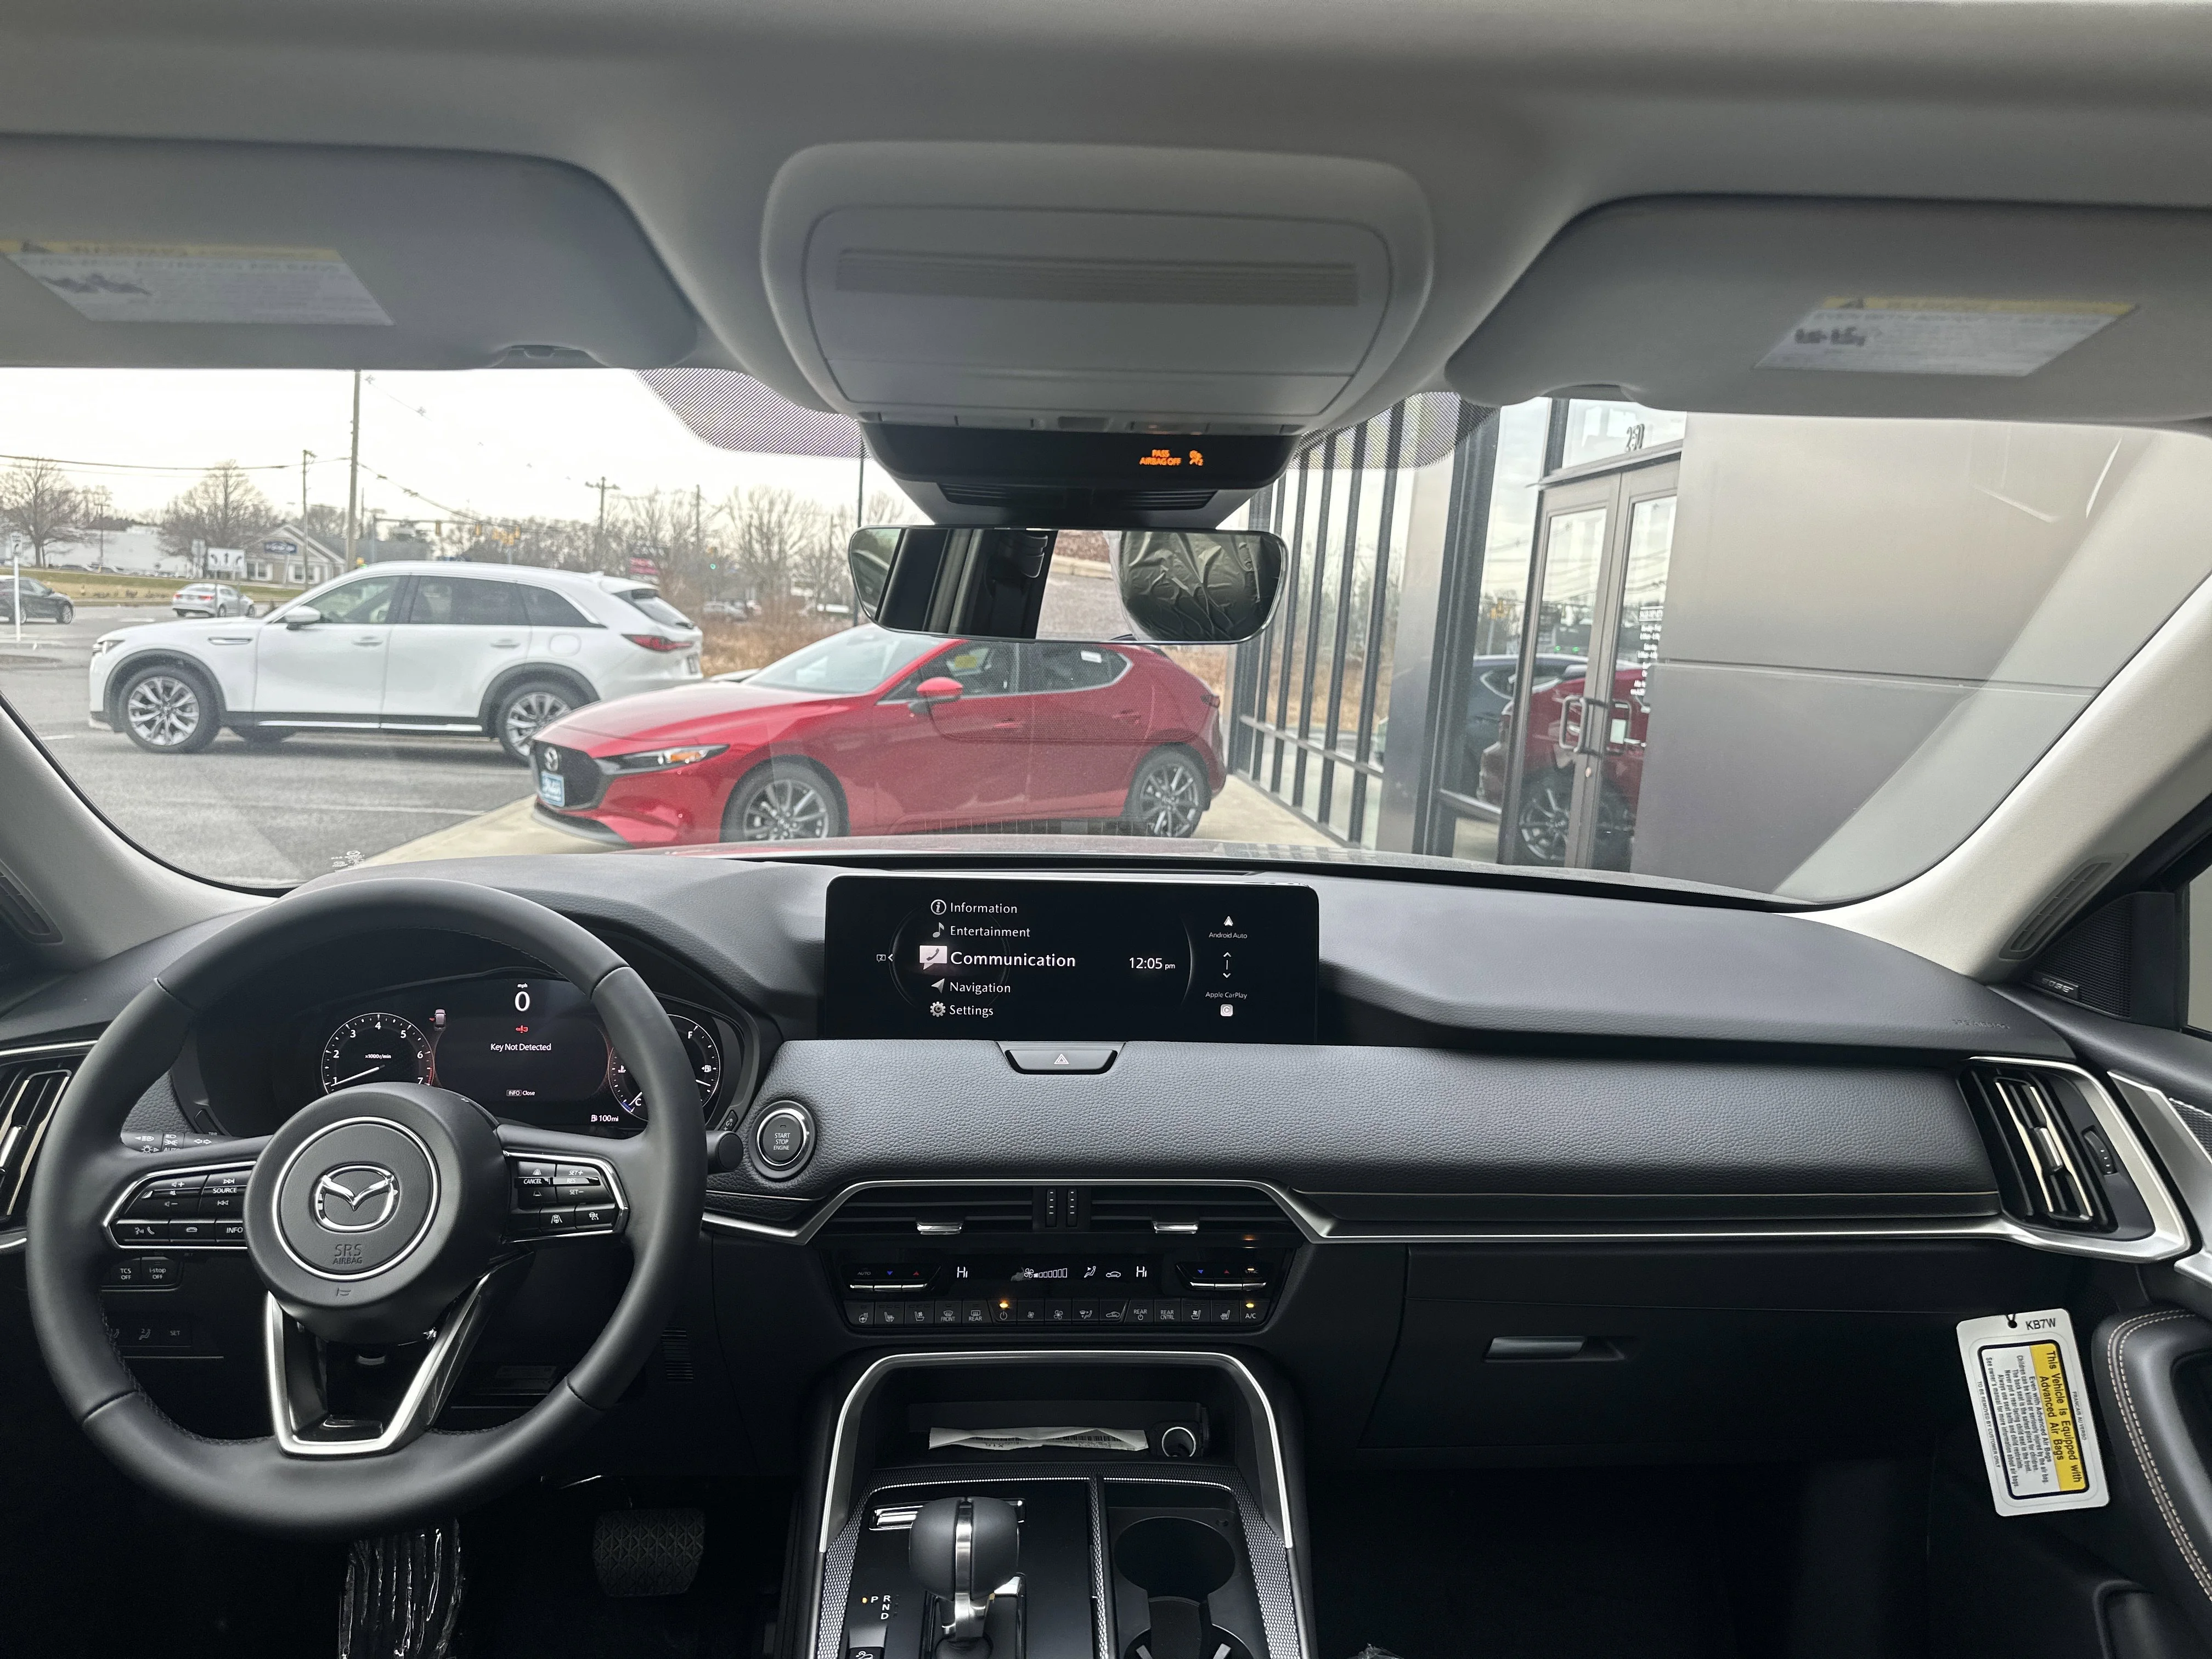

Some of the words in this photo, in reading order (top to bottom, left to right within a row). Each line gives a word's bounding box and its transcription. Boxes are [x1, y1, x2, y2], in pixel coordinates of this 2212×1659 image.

[1139, 457, 1167, 465] AIRBAG
[950, 902, 1018, 914] Information
[950, 926, 1031, 937] Entertainment
[950, 952, 1076, 967] Communication
[1129, 957, 1163, 969] 12:05
[950, 982, 1011, 995] Navigation
[2041, 978, 2074, 993] BOSE
[514, 991, 531, 1012] 0
[950, 1005, 994, 1019] Settings
[375, 1022, 381, 1030] 4
[350, 1030, 356, 1038] 3
[400, 1030, 407, 1039] 5
[688, 1031, 693, 1039] F
[333, 1050, 340, 1058] 2
[490, 1043, 504, 1052] Key
[505, 1043, 518, 1051] Not
[519, 1043, 551, 1051] Detected
[417, 1050, 424, 1059] 6
[635, 1098, 642, 1106] C
[334, 1244, 363, 1257] SRS
[2025, 1318, 2057, 1330] KB7W
[2046, 1350, 2057, 1369] This
[2016, 1355, 2025, 1375] Children
[2025, 1392, 2033, 1405] killed
[2051, 1373, 2064, 1403] Vehicle
[2016, 1391, 2024, 1401] seat
[2039, 1376, 2057, 1417] Advanced
[1988, 1368, 1997, 1386] owner's
[1993, 1387, 2002, 1404] manual
[2001, 1426, 2011, 1453] information
[2007, 1454, 2016, 1466] about
[2022, 1415, 2030, 1430] safest
[2036, 1407, 2047, 1435] Advanced
[1980, 1396, 1989, 1419] REMOVED
[1988, 1428, 1997, 1454] CUSTOMER
[2016, 1423, 2024, 1435] child
[2049, 1422, 2060, 1434] Air
[2024, 1430, 2032, 1443] place
[2061, 1420, 2078, 1460] Equipped
[2053, 1438, 2063, 1460] Bags
[2070, 1464, 2081, 1482] with
